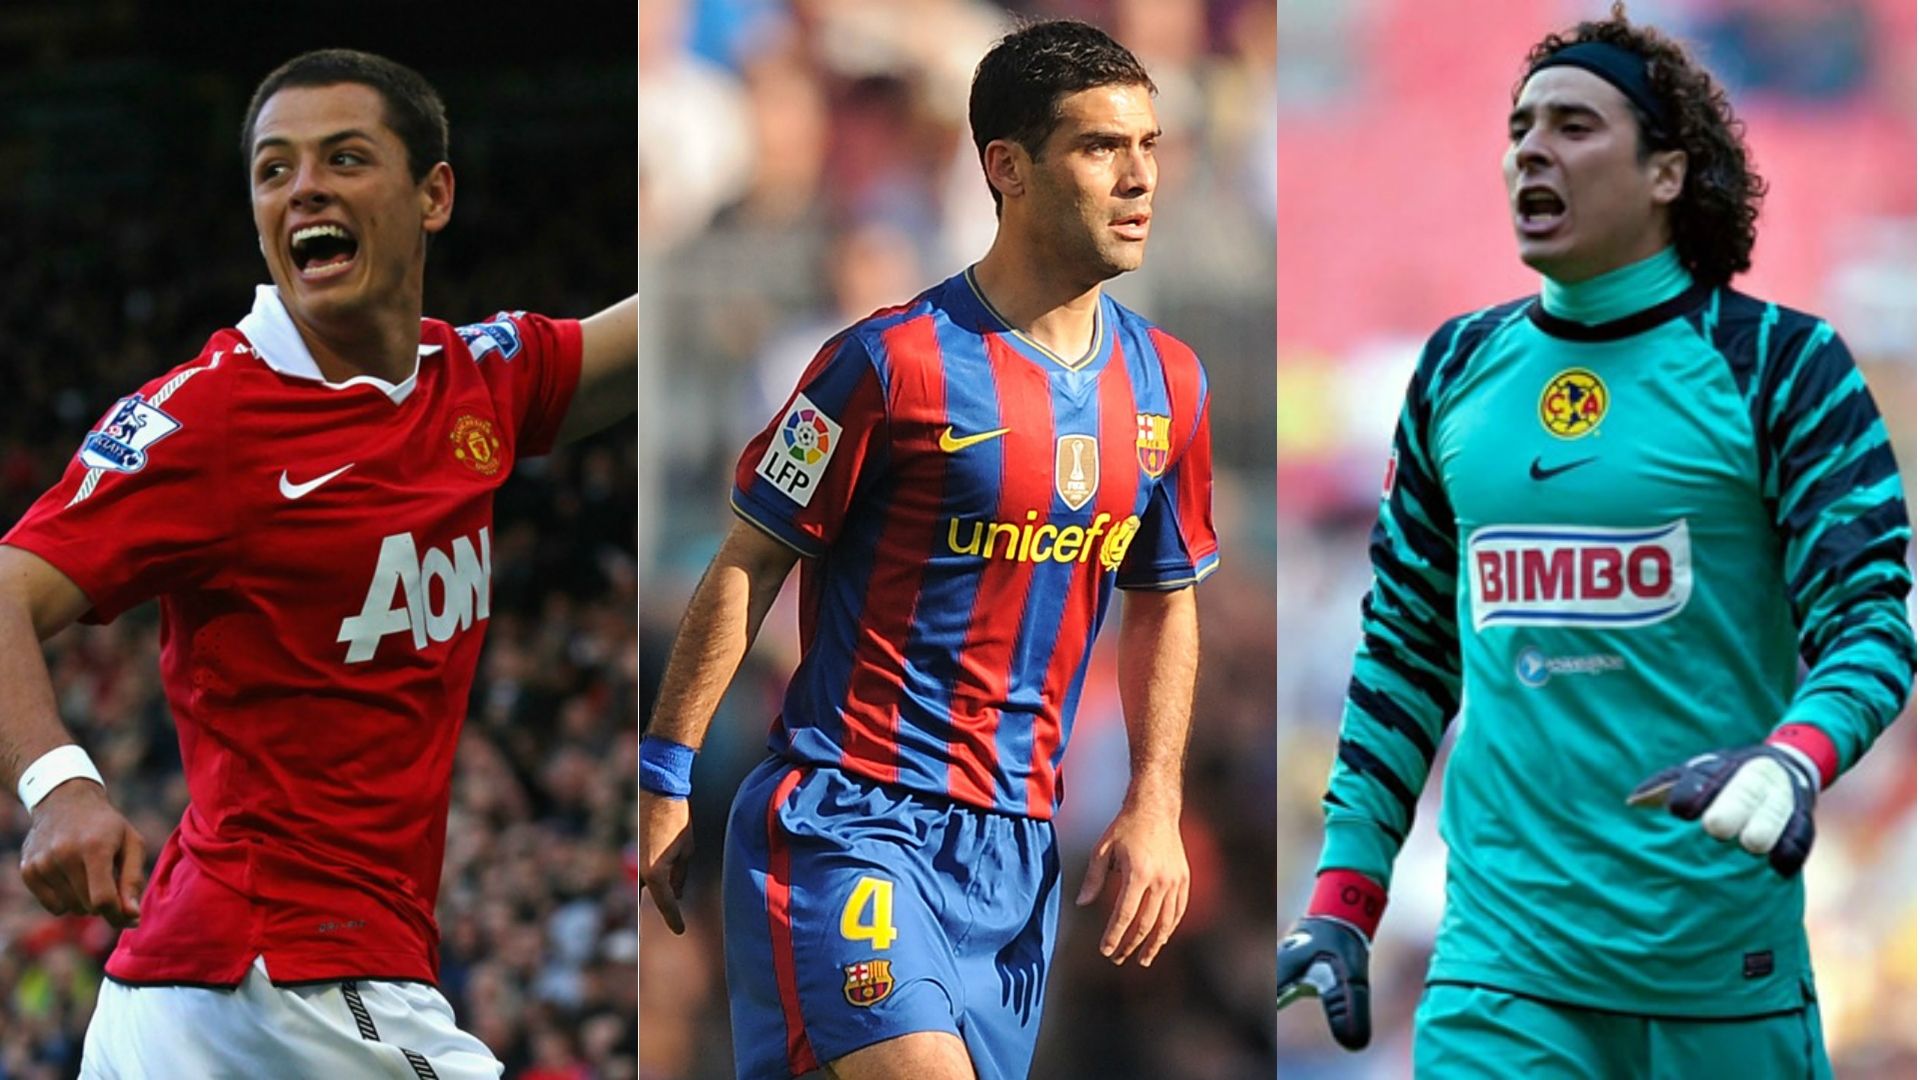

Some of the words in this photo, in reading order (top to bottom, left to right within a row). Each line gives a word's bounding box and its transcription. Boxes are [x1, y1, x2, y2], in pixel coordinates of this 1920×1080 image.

[763, 451, 811, 494] LFP
[948, 510, 1110, 564] unicef
[336, 525, 490, 663] AON
[1476, 544, 1674, 603] BIMBO
[839, 875, 898, 951] 4
